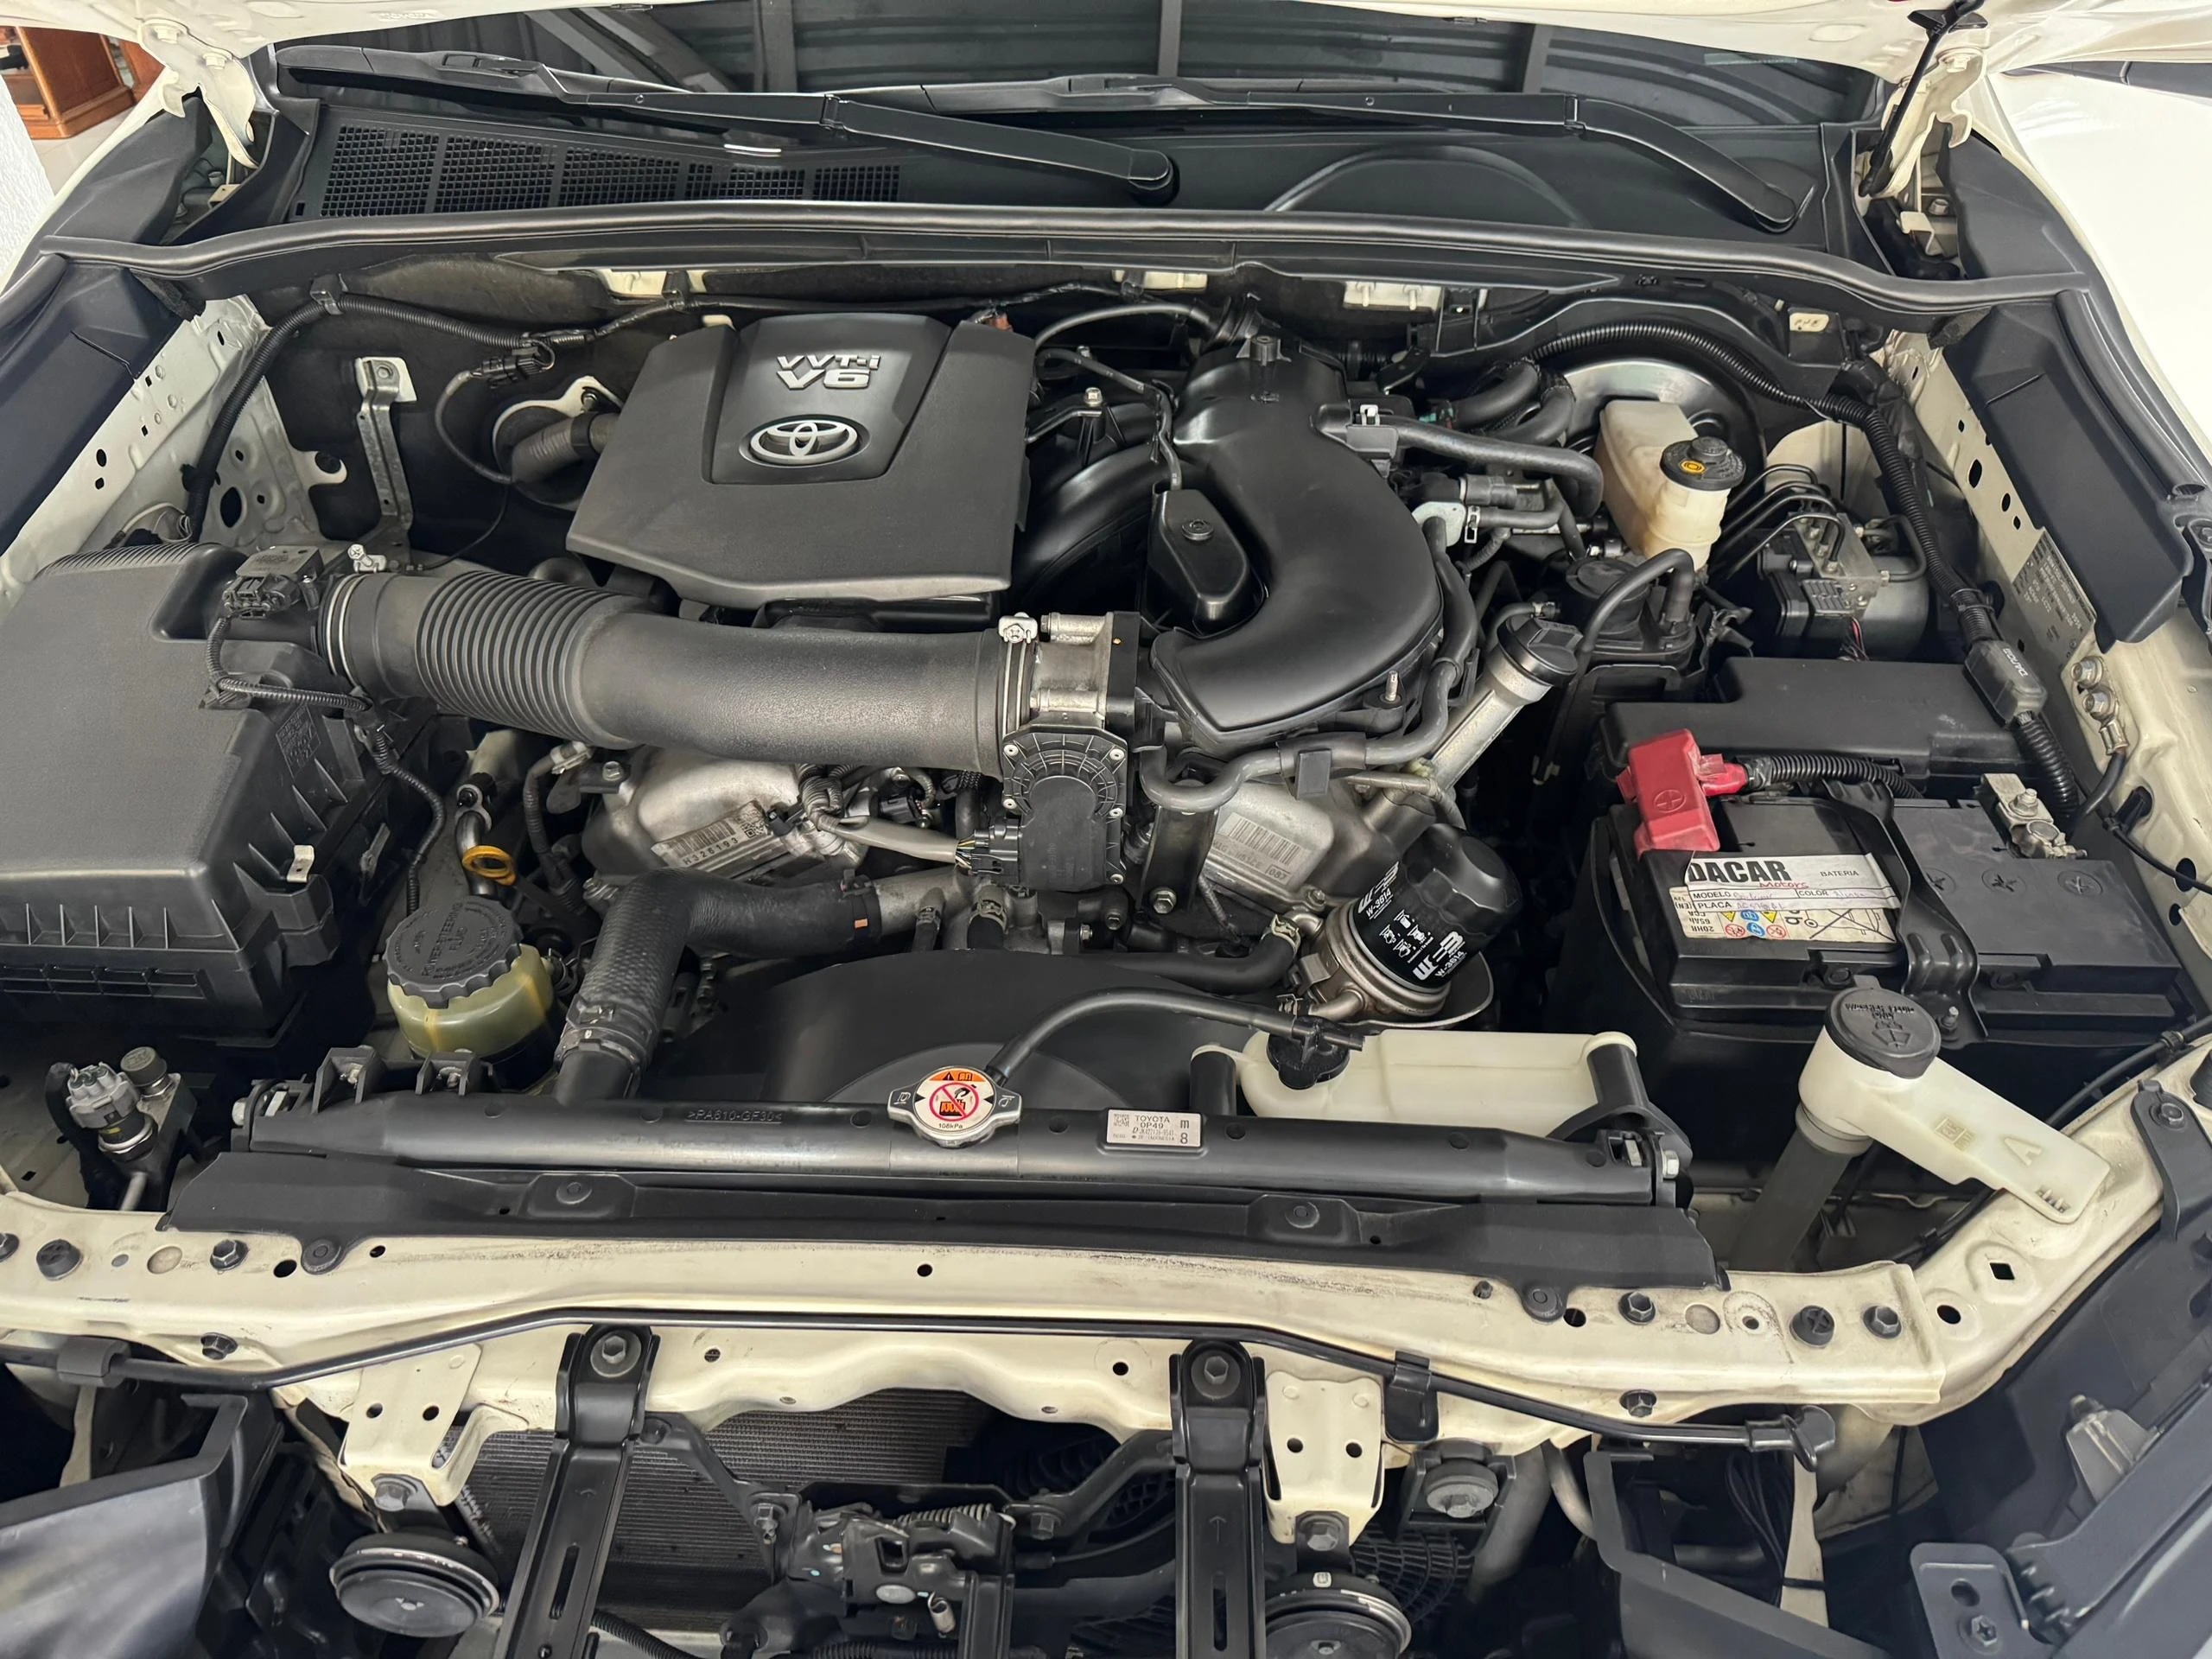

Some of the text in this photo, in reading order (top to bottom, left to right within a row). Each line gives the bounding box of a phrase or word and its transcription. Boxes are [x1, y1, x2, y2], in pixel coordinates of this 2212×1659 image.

[777, 355, 881, 370] VVT-i
[776, 369, 871, 390] V6
[1688, 861, 1792, 883] DACAR
[1366, 888, 1392, 917] W-3614
[1135, 1115, 1170, 1123] TOYOTA
[1180, 1132, 1188, 1144] 8
